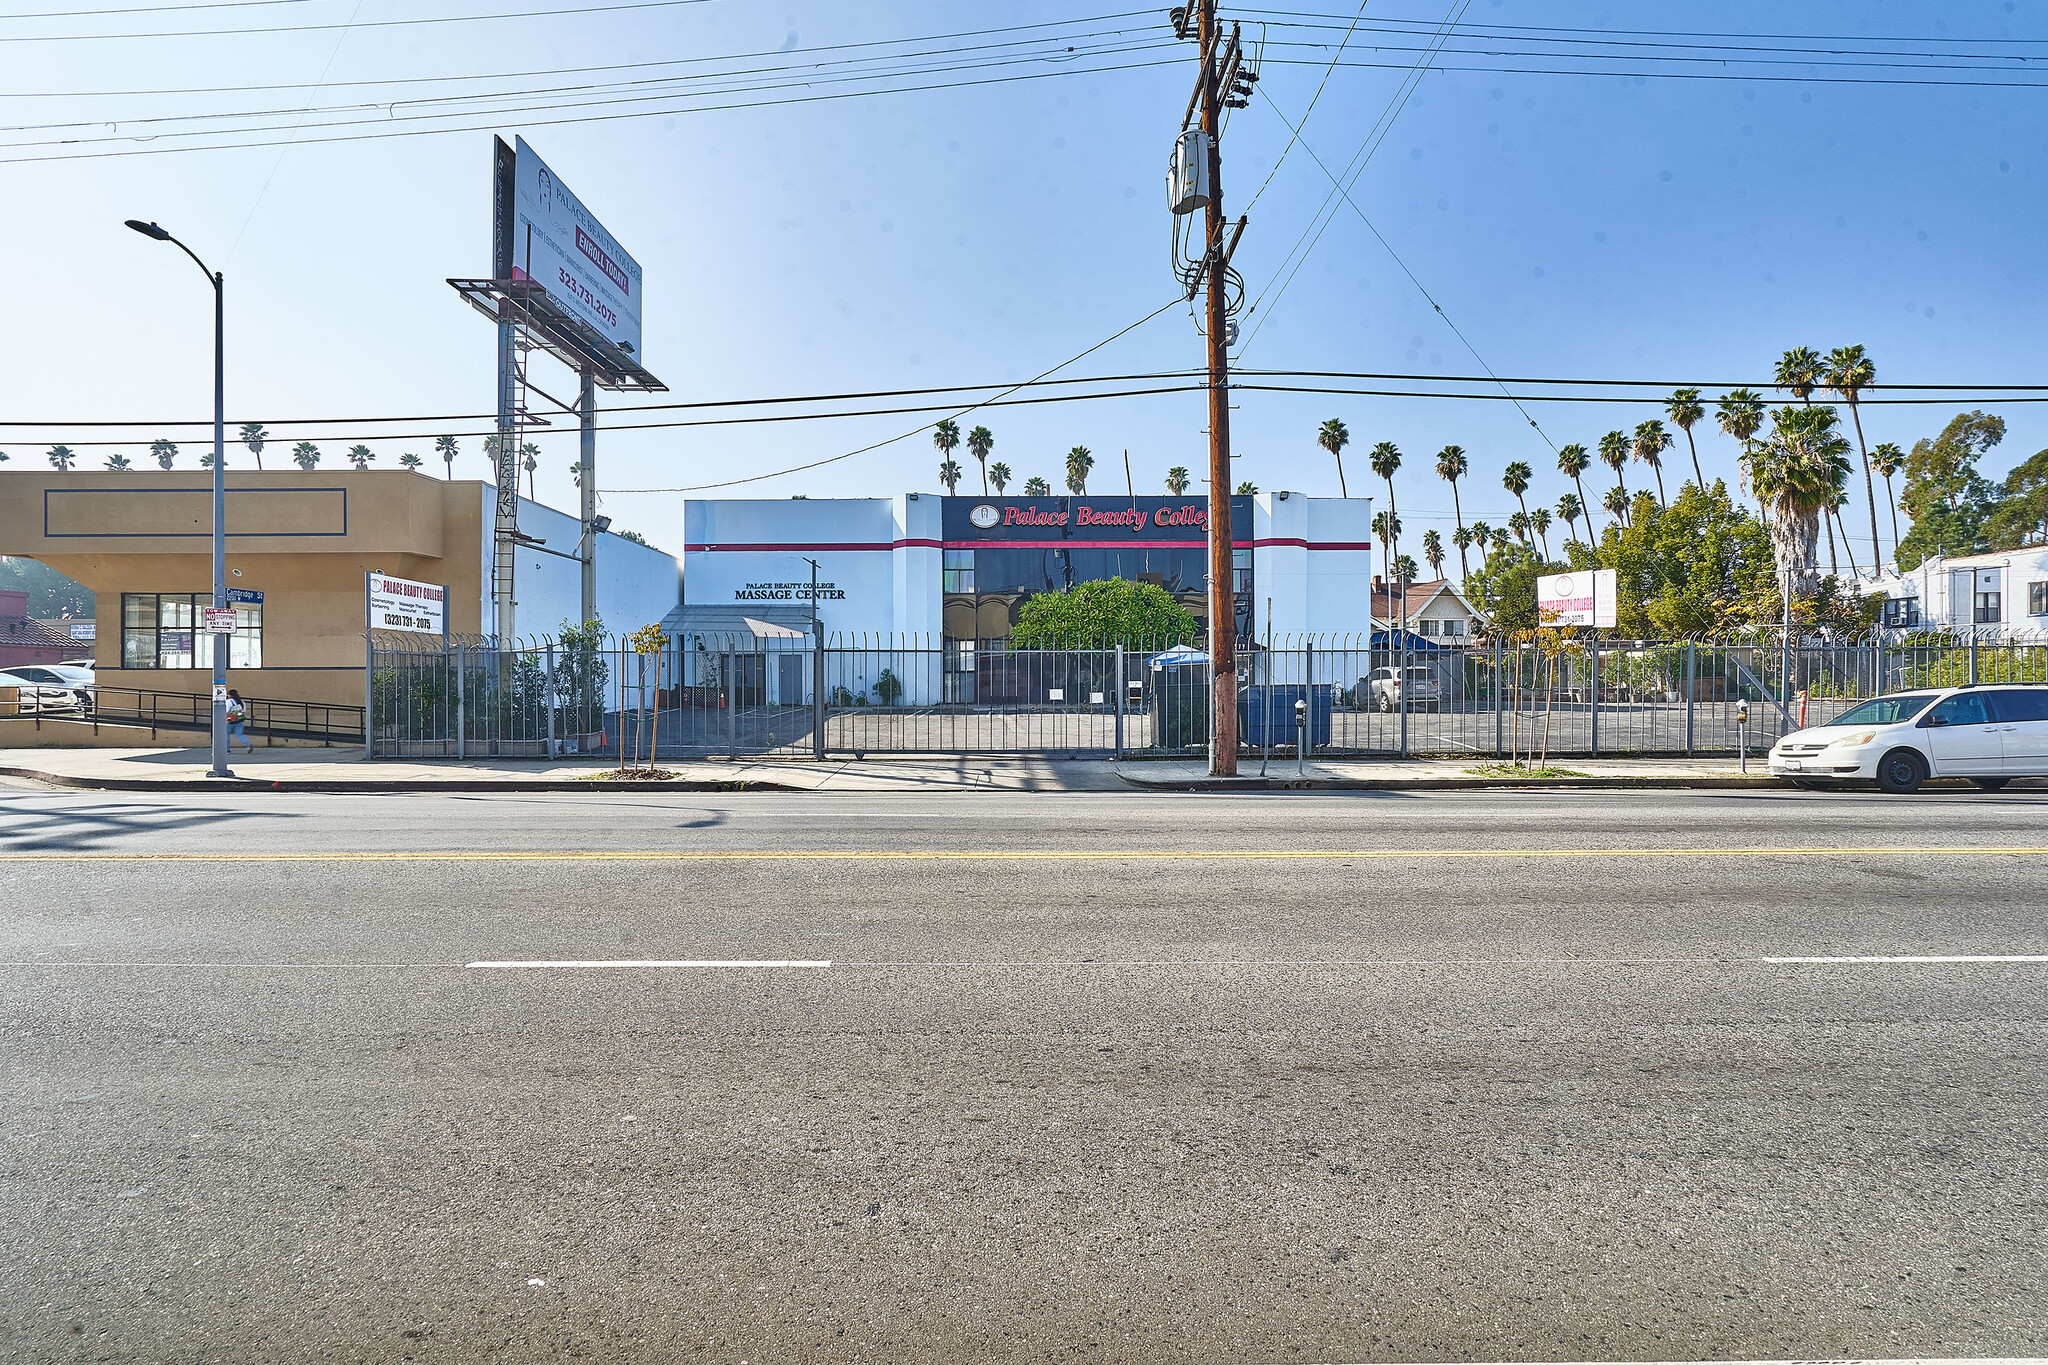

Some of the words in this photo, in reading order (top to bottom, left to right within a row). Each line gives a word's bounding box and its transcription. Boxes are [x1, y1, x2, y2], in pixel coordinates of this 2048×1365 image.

[556, 186, 585, 228] PALACE
[587, 219, 613, 257] BEAUTY
[615, 249, 641, 285] COLLEGE
[579, 231, 604, 269] ENROLL
[605, 257, 625, 290] TODAY!
[558, 265, 616, 328] 323.731.2075
[1003, 506, 1068, 525] Palace
[1076, 506, 1147, 530] Beauty
[226, 588, 254, 599] Cambridge
[383, 580, 402, 595] PALACE
[404, 584, 422, 598] BEAUTY
[424, 588, 442, 601] COLLEGE
[735, 590, 792, 600] MASSAGE
[371, 597, 395, 606] Cosmetology
[371, 603, 390, 611] Barbering
[1573, 596, 1593, 612] COLLEGE
[384, 613, 402, 626] (323)
[402, 615, 413, 628] 731
[416, 617, 431, 630] 2075
